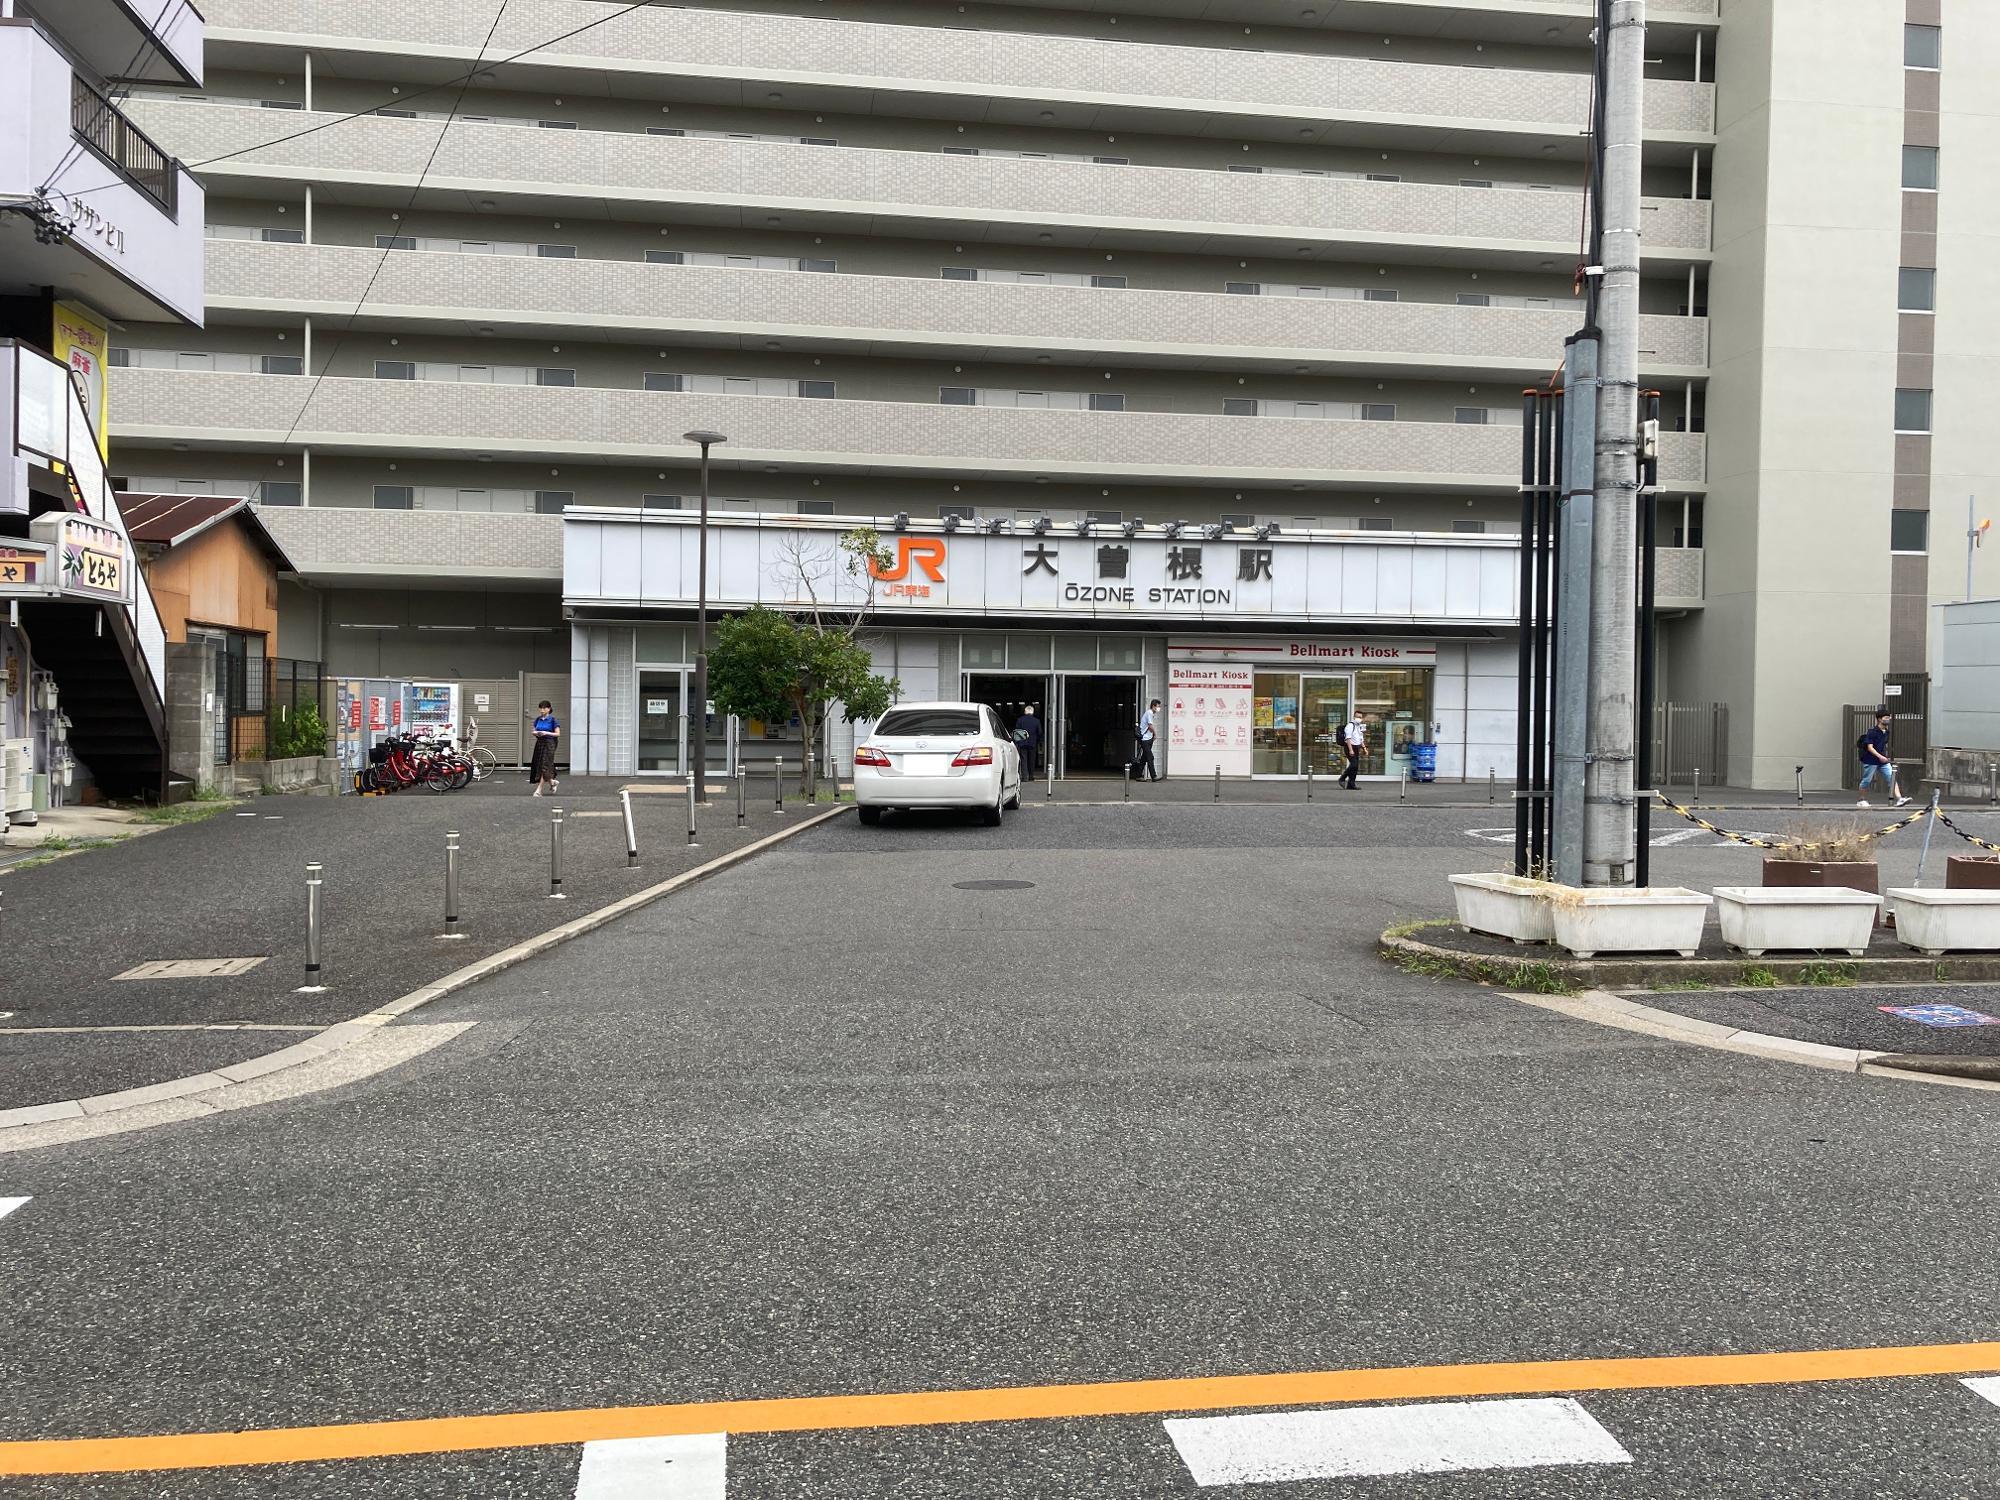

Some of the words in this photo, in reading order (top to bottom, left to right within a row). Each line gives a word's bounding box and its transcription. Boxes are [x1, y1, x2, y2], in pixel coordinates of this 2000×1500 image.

[88, 555, 117, 588] とらや
[868, 536, 946, 583] JR
[1023, 543, 1272, 582] 大曽根駅
[1065, 582, 1135, 602] ŌZONE
[1148, 587, 1230, 604] STATION
[1290, 644, 1355, 657] Bellmart
[1361, 646, 1400, 658] Kiosk
[1173, 669, 1217, 679] Bellmart
[1222, 670, 1249, 680] Kiosk
